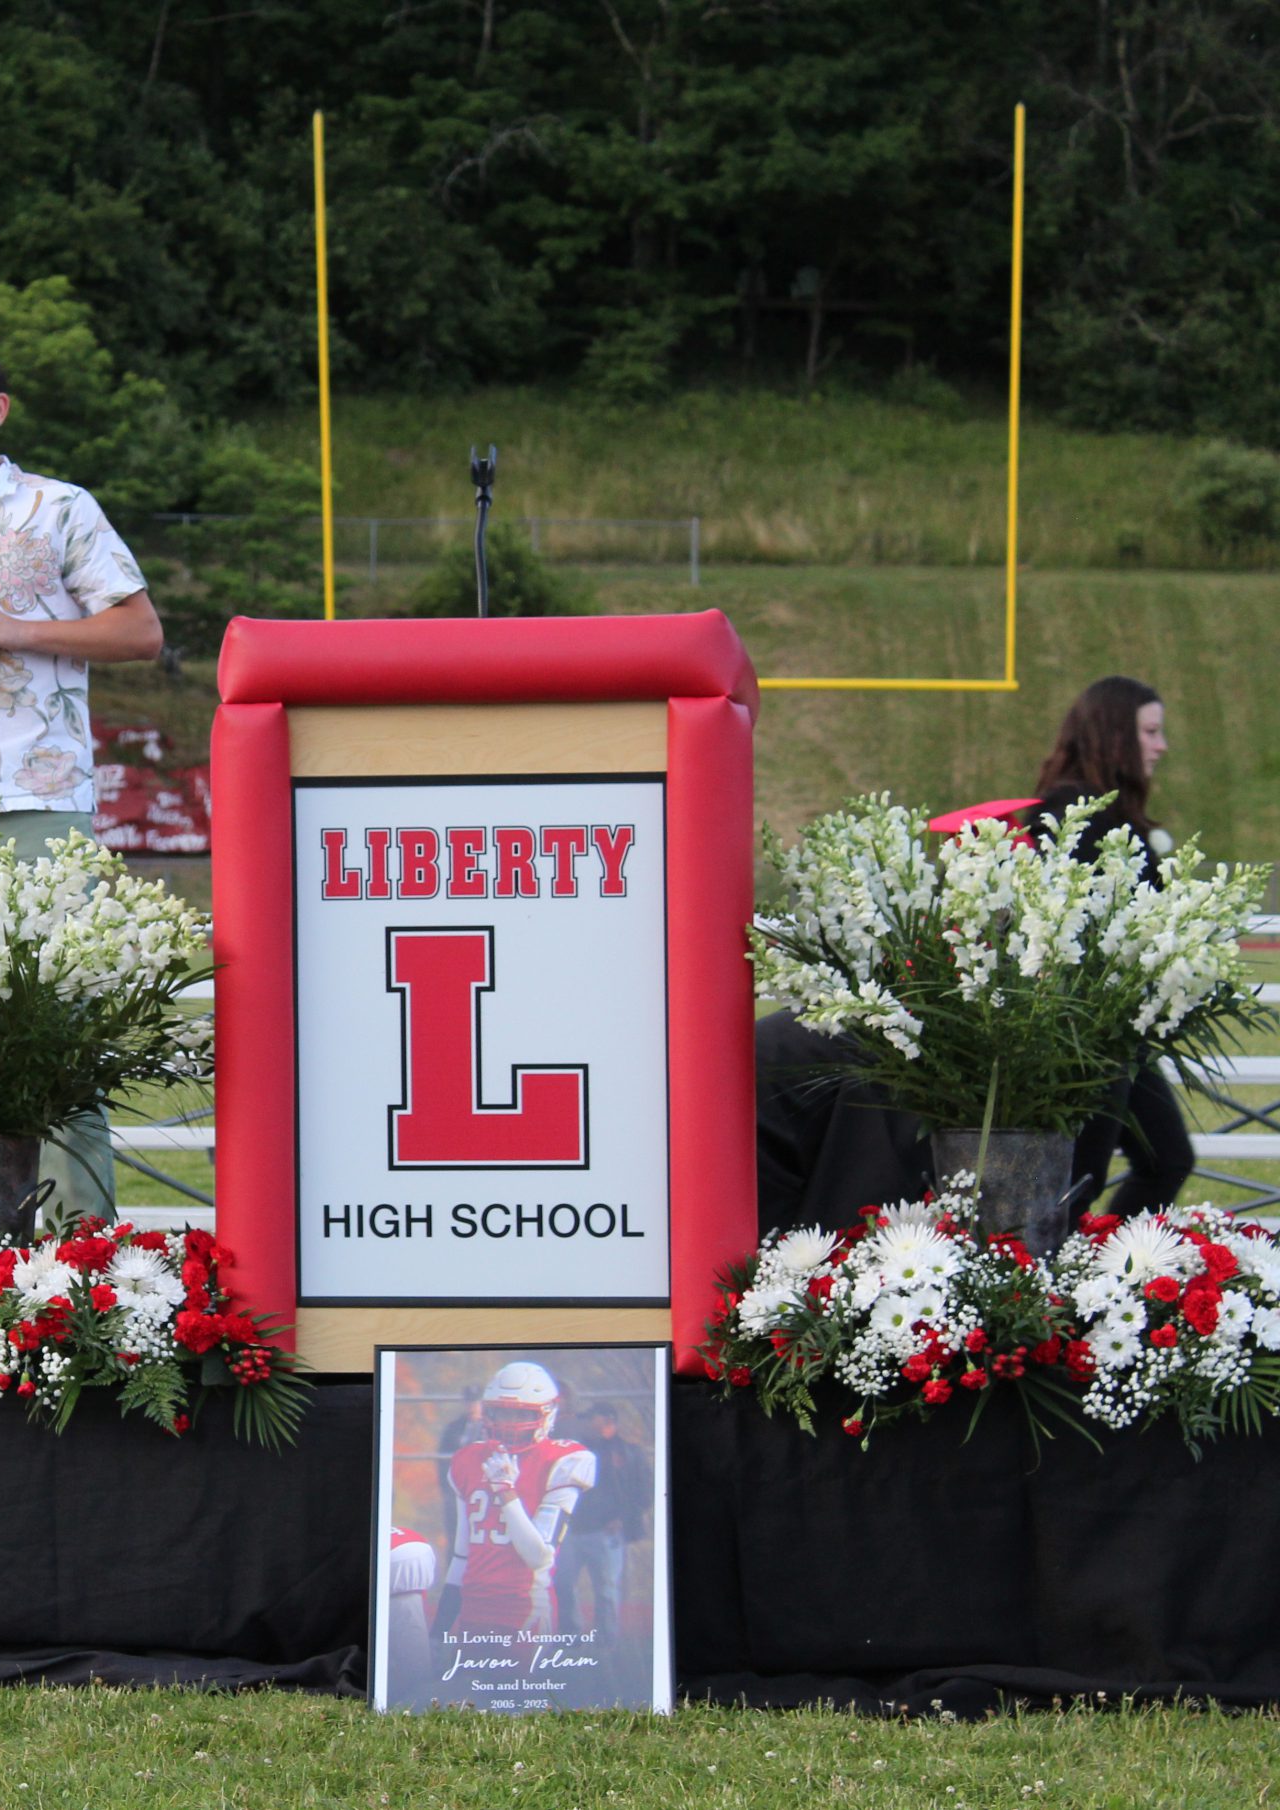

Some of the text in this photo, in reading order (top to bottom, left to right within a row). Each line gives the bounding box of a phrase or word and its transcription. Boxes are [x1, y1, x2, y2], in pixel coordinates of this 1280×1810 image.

[321, 824, 635, 900] LIBERTY
[385, 925, 590, 1171] L
[323, 1203, 645, 1238] HIGH SCHOOL
[443, 1629, 597, 1647] In Loving Memory of
[442, 1645, 598, 1681] Javon Islam
[472, 1679, 567, 1691] Son and brother
[491, 1699, 515, 1709] 2005
